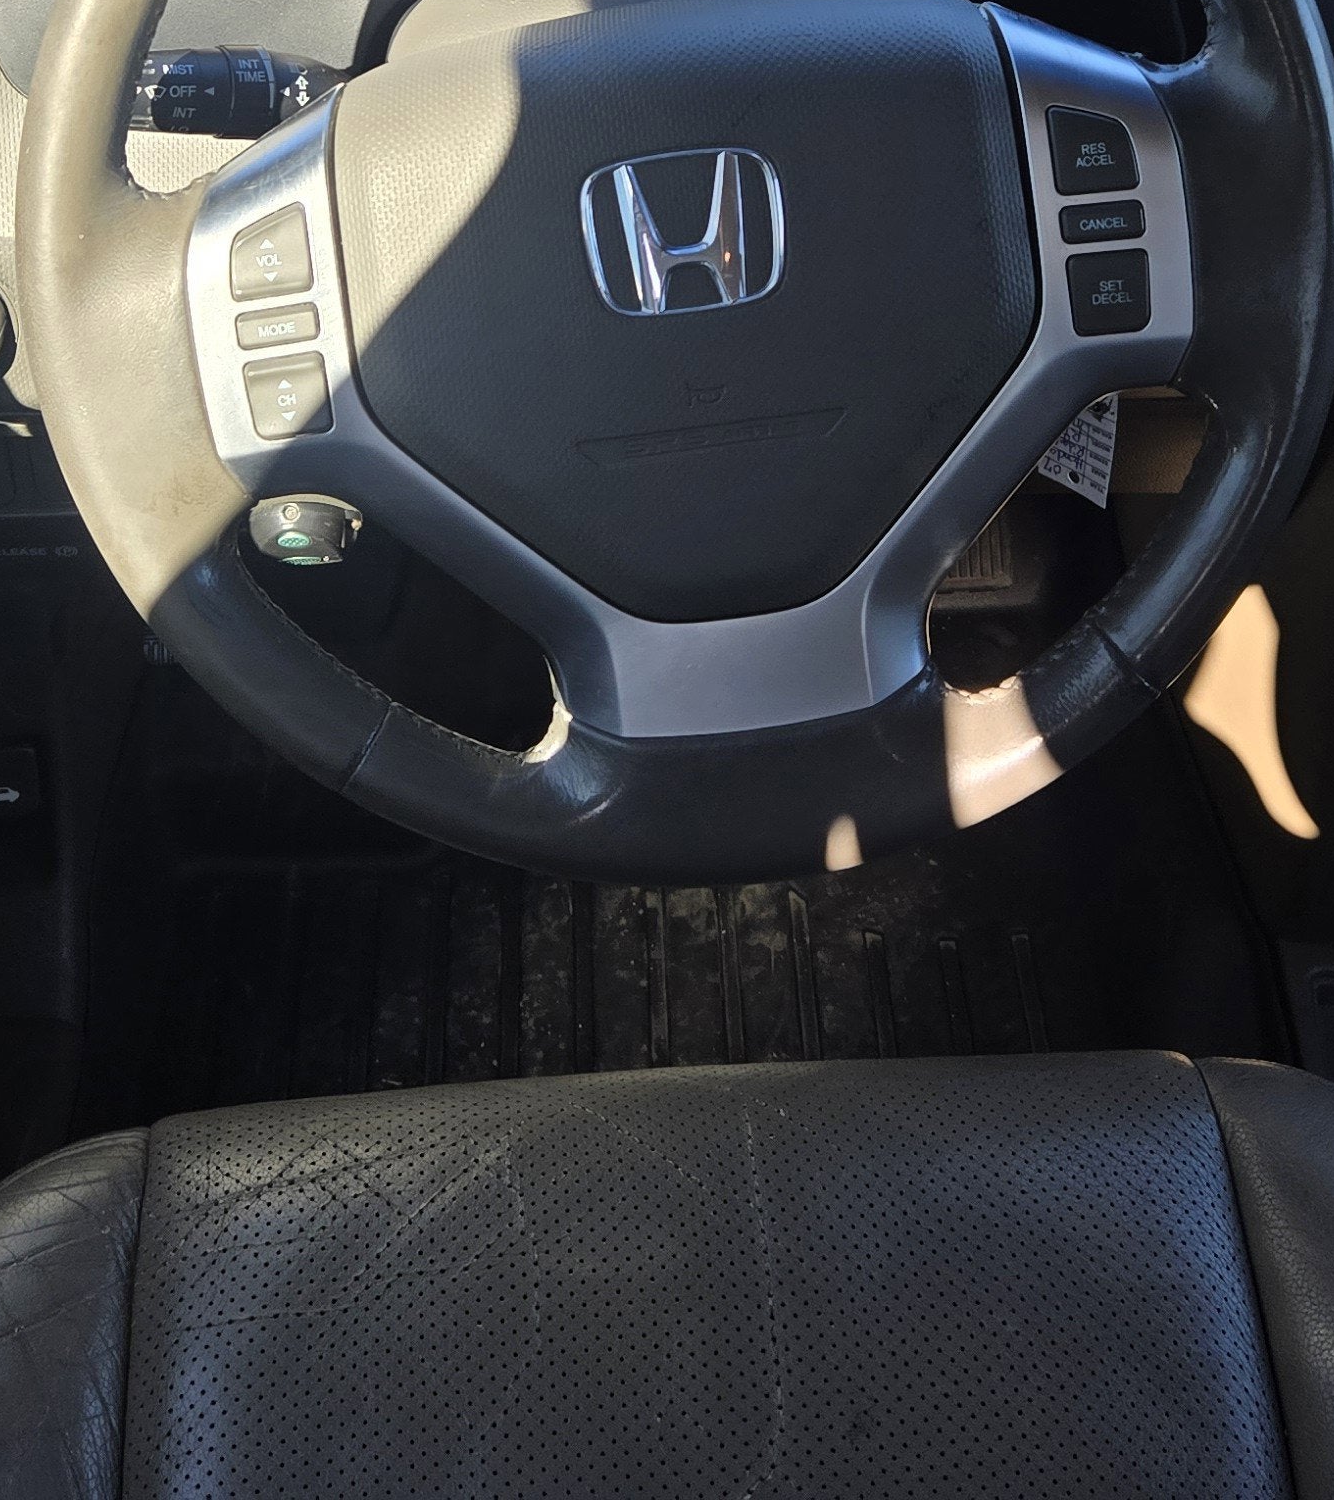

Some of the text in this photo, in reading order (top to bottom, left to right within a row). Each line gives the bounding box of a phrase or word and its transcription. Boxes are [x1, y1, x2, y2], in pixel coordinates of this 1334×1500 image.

[163, 64, 194, 75] MIST
[238, 59, 260, 69] INT
[236, 70, 266, 83] TIME
[169, 85, 197, 98] OFF
[173, 106, 197, 118] INT
[1081, 142, 1106, 155] RES
[1076, 154, 1115, 168] ACCEL
[1079, 217, 1128, 231] CANCEL
[255, 254, 282, 267] VOL
[1099, 279, 1123, 292] SET
[1092, 291, 1132, 305] DECEL
[257, 322, 296, 338] MODE
[277, 393, 296, 407] CH
